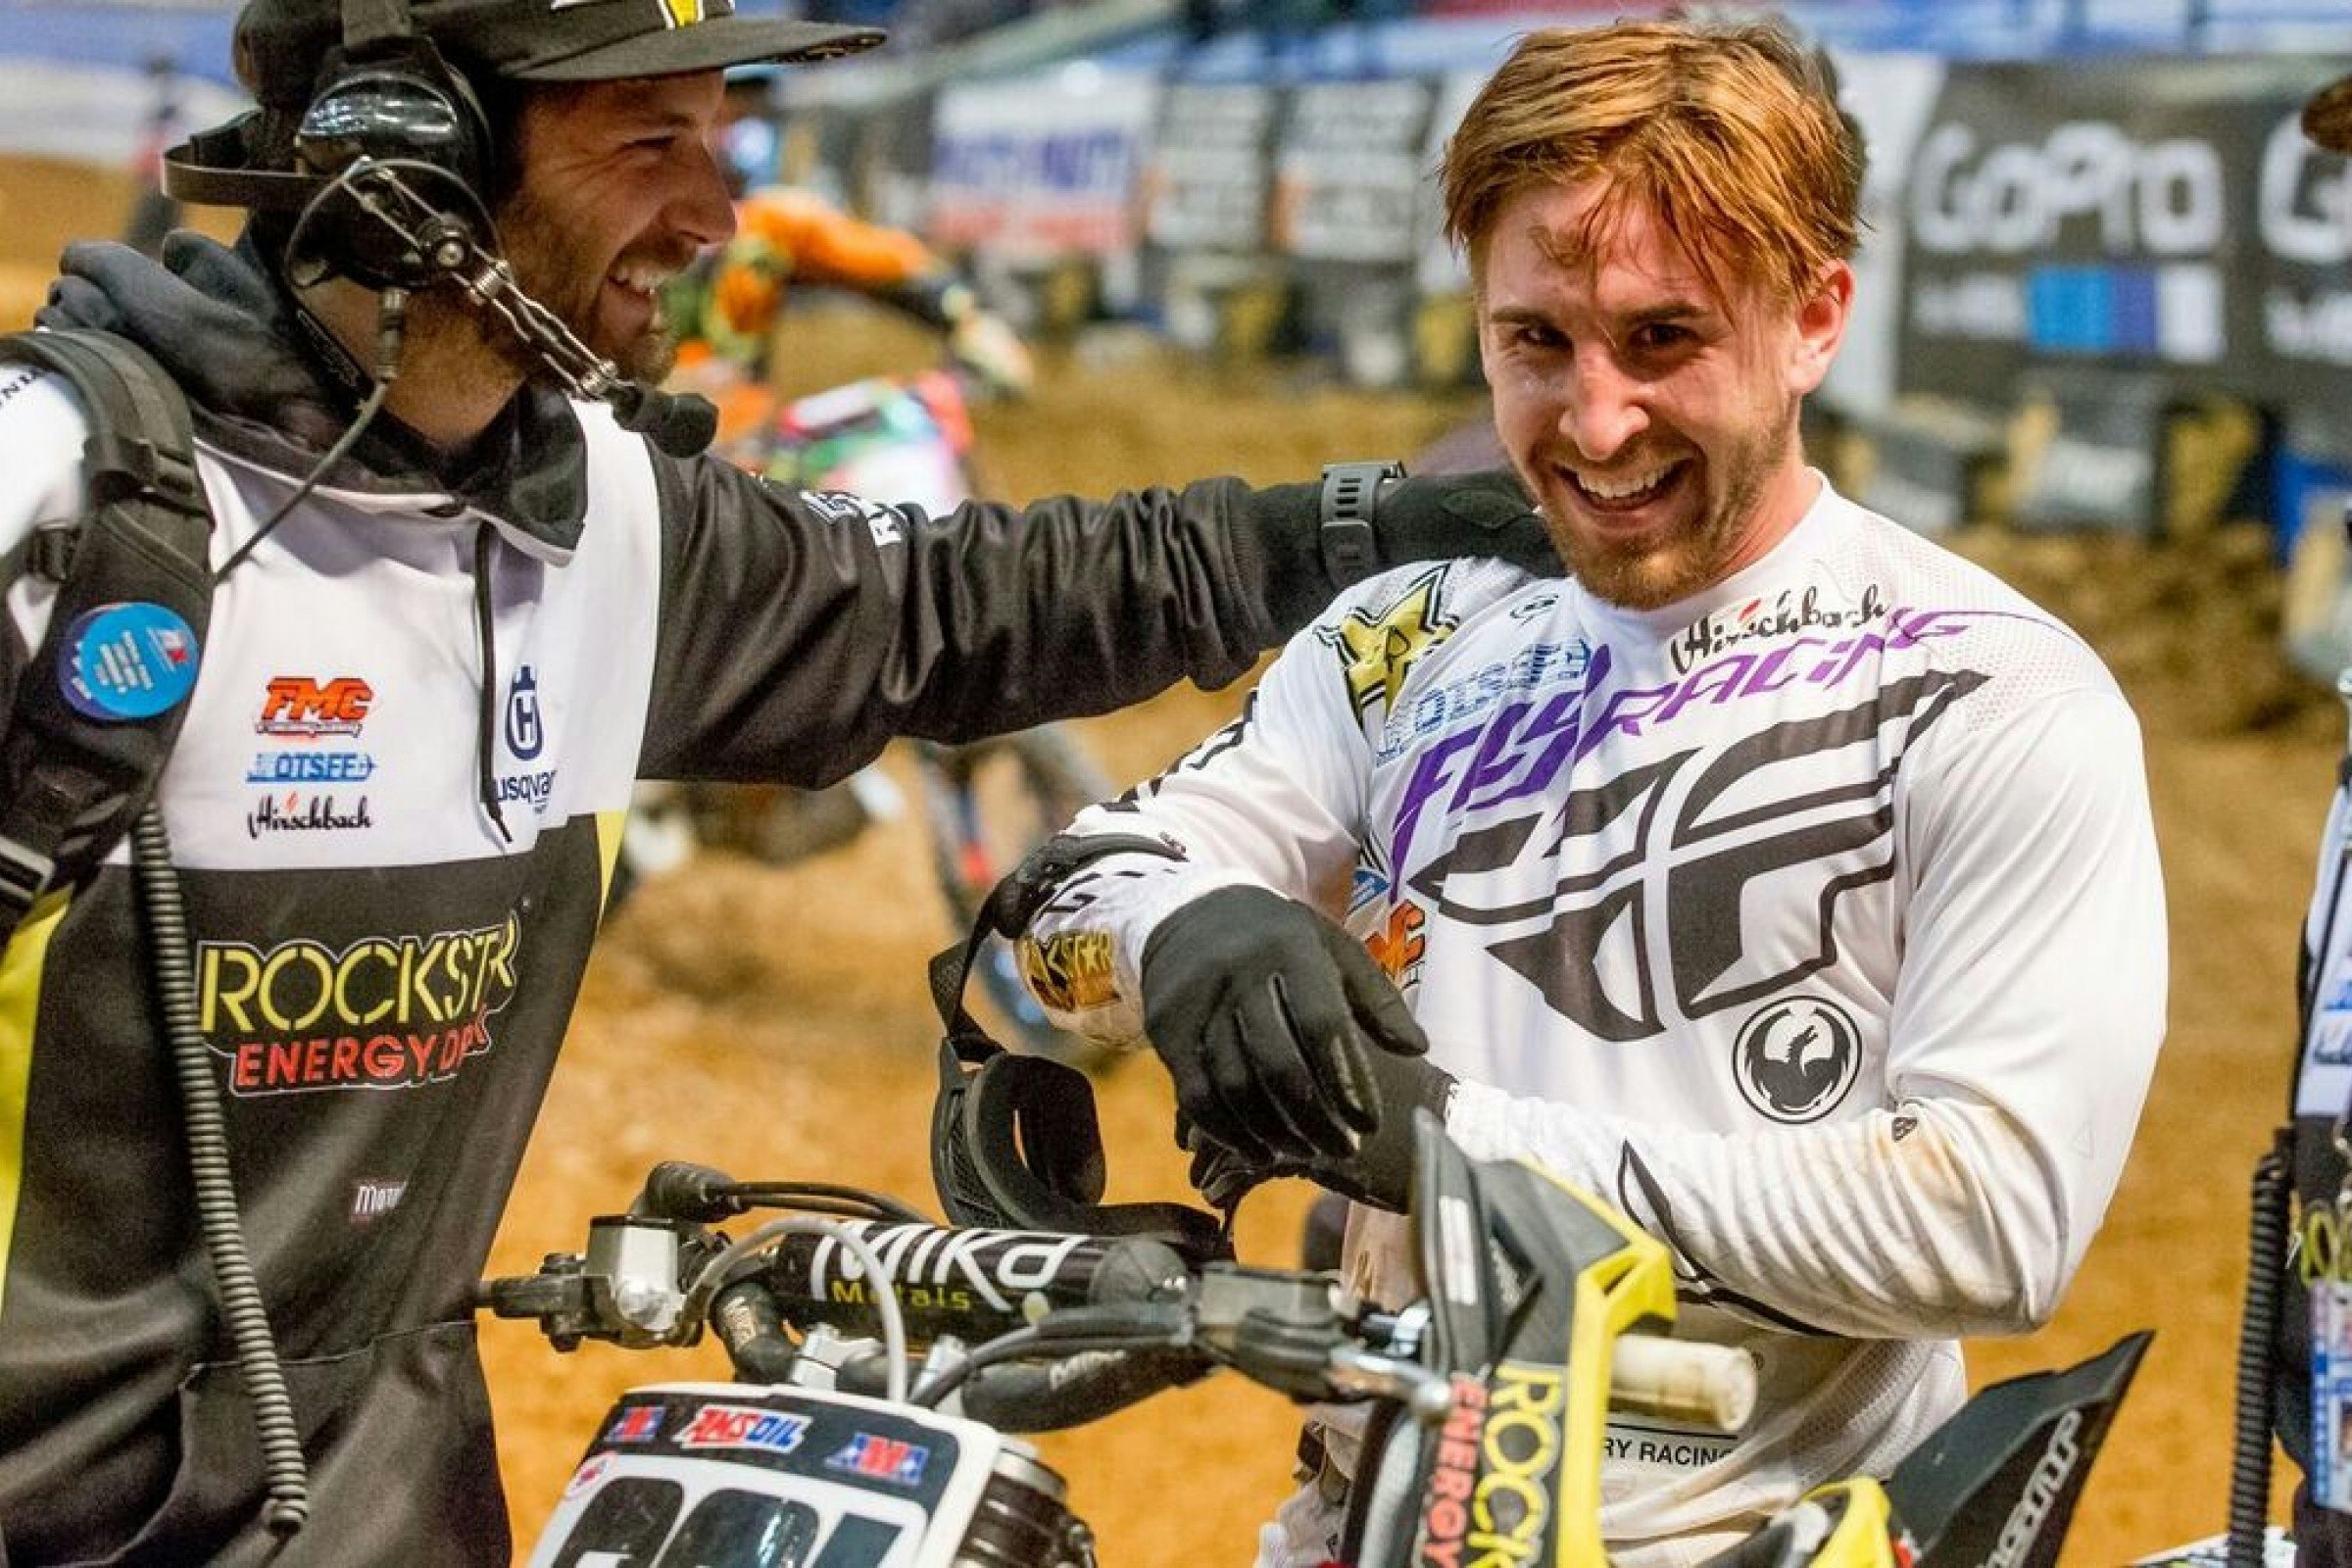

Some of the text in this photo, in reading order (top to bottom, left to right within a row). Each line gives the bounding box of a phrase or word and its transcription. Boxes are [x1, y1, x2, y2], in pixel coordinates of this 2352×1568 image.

[235, 1034, 438, 1087] ENERGY
[831, 1280, 973, 1311] Mtals
[1604, 1437, 1633, 1458] RY
